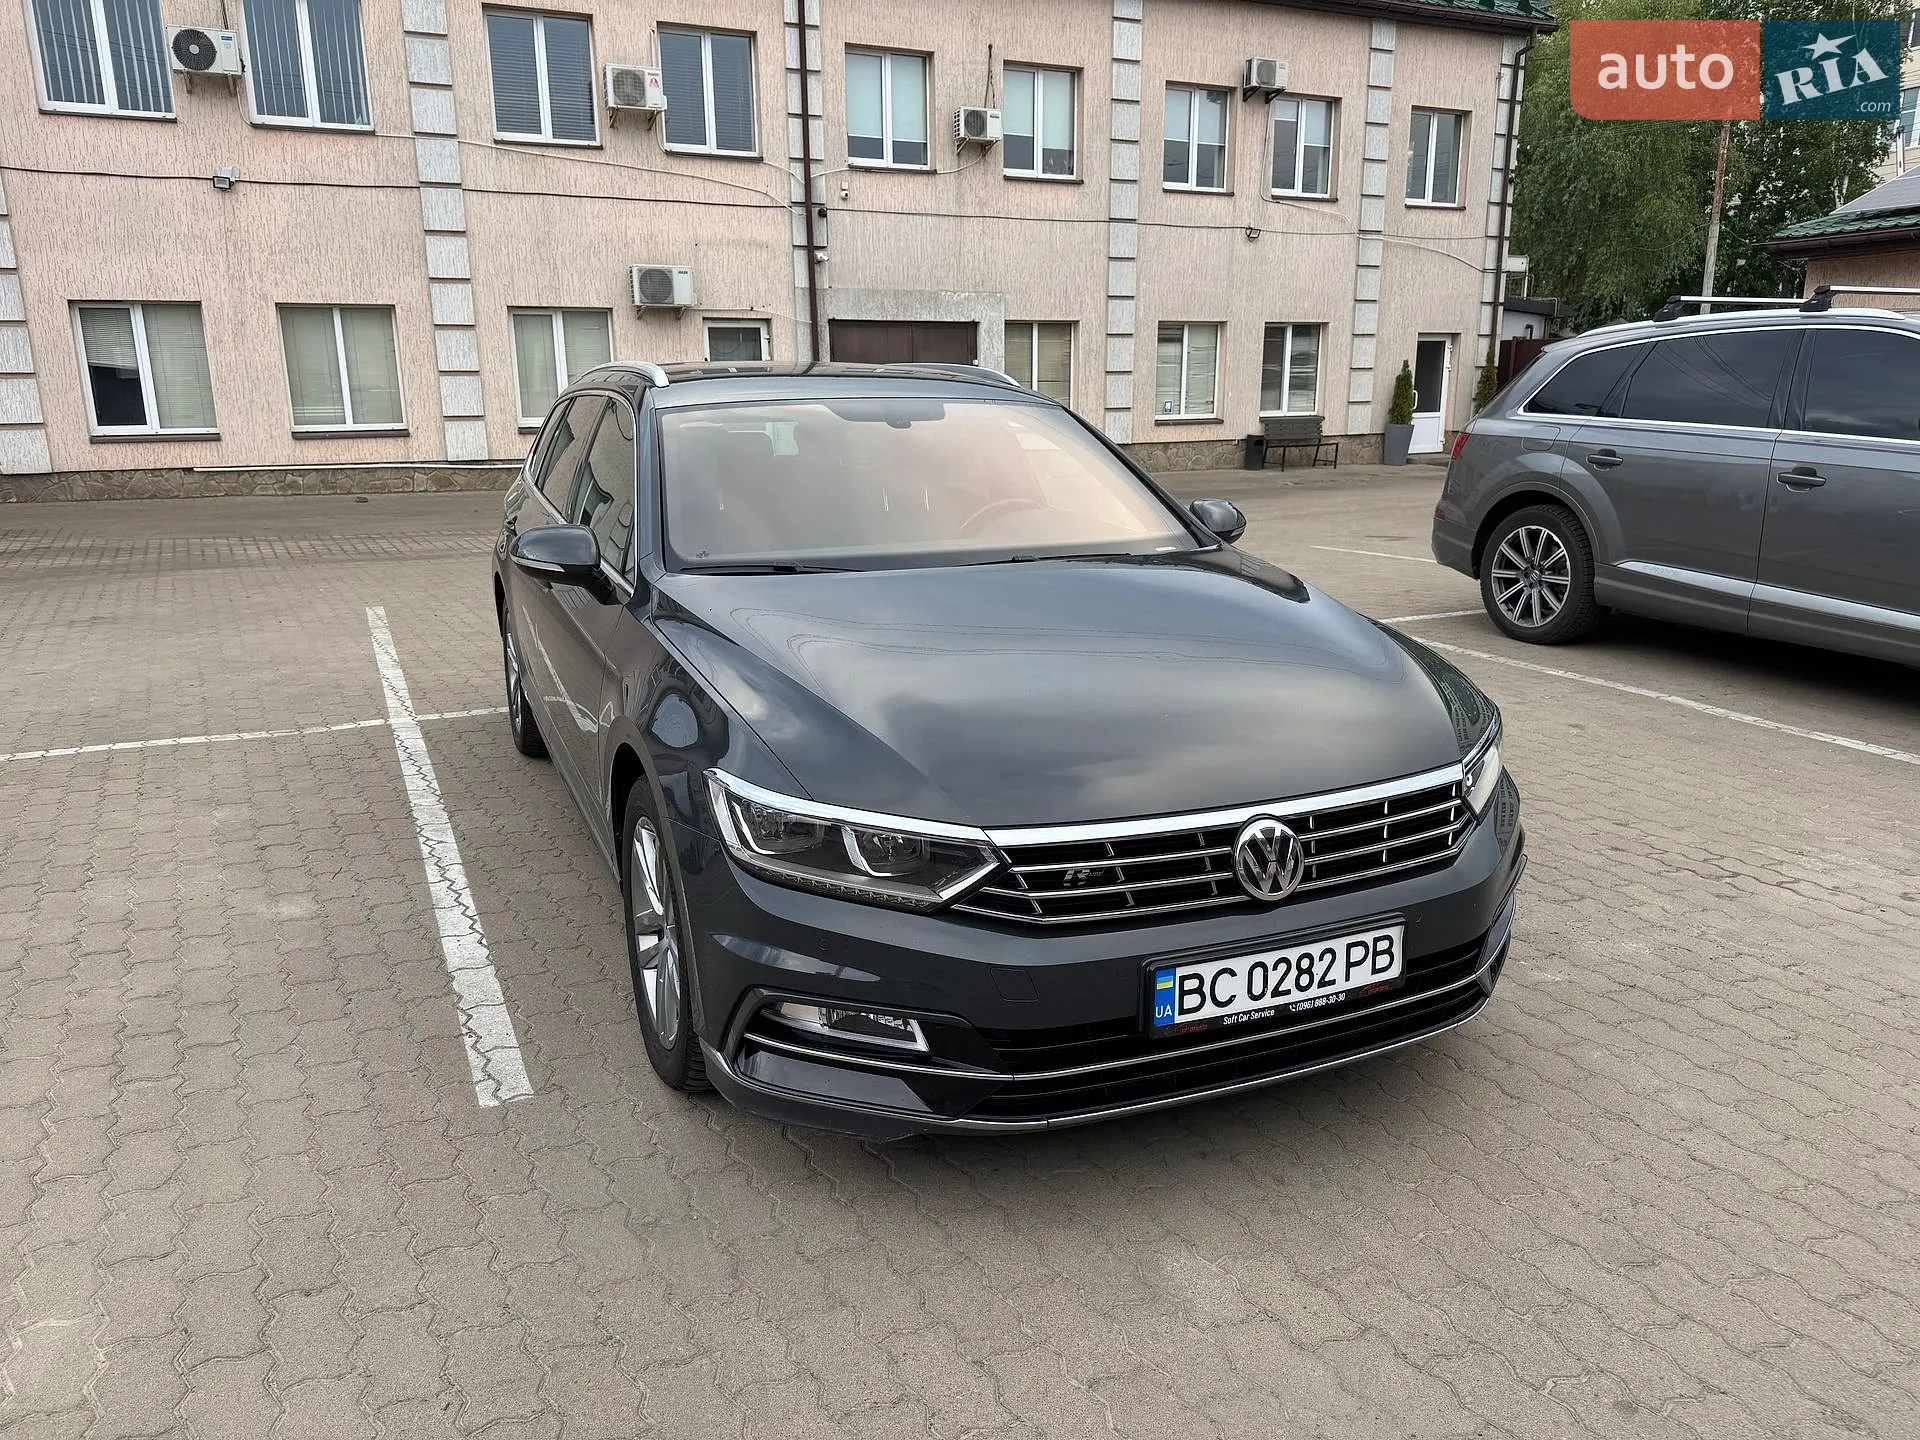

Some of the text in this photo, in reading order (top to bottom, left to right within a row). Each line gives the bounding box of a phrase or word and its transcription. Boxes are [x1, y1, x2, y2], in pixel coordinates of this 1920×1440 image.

[1177, 933, 1395, 1016] BC 0282 PB
[1155, 1005, 1173, 1018] UA
[1223, 1008, 1275, 1025] Soft Car Service
